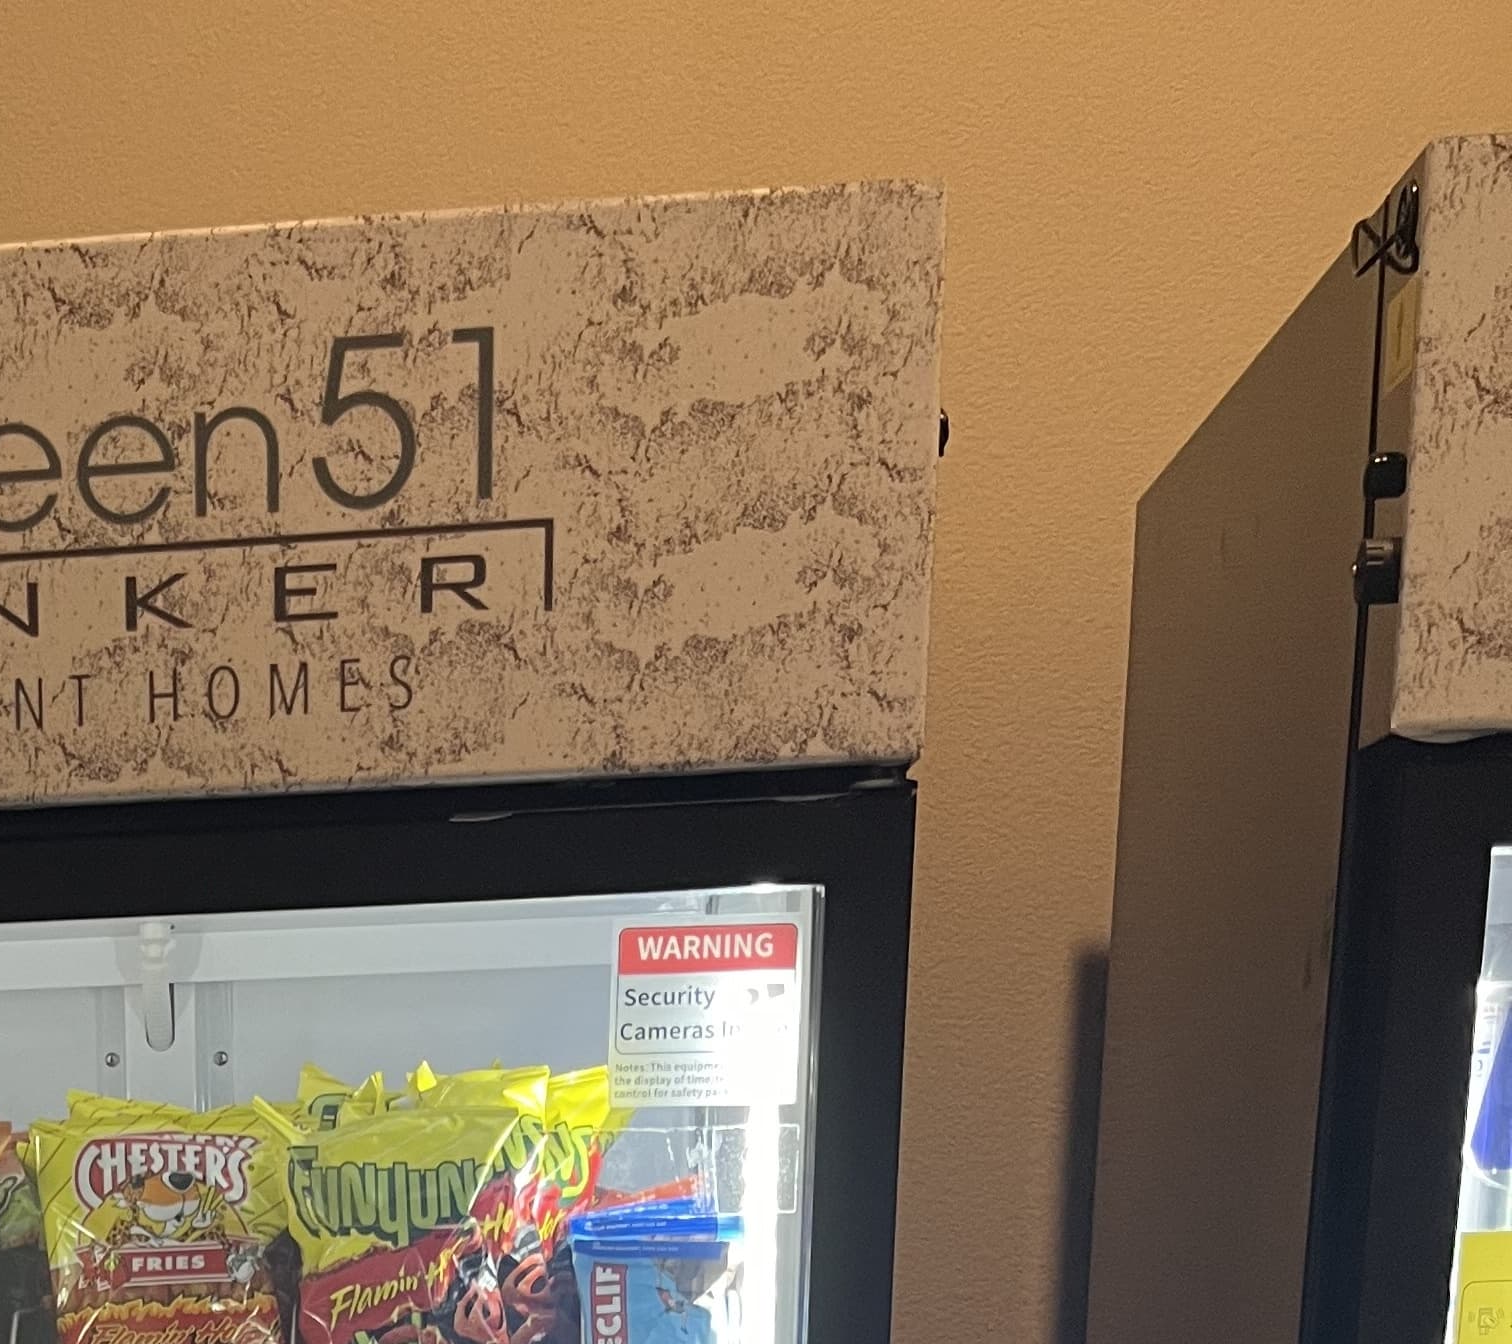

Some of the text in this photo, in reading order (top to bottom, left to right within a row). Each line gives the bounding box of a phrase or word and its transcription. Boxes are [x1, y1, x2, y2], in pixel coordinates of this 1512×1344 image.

[148, 654, 417, 725] HOMES
[637, 932, 774, 961] WARNING
[624, 985, 715, 1010] Security
[620, 1022, 715, 1041] Cameras
[651, 1061, 672, 1073] This
[614, 1074, 685, 1088] the display of
[654, 1087, 669, 1098] for
[671, 1086, 704, 1099] safety
[77, 1140, 249, 1212] CHESTER'S
[131, 1254, 206, 1273] FRIES
[595, 1266, 621, 1336] CLIF
